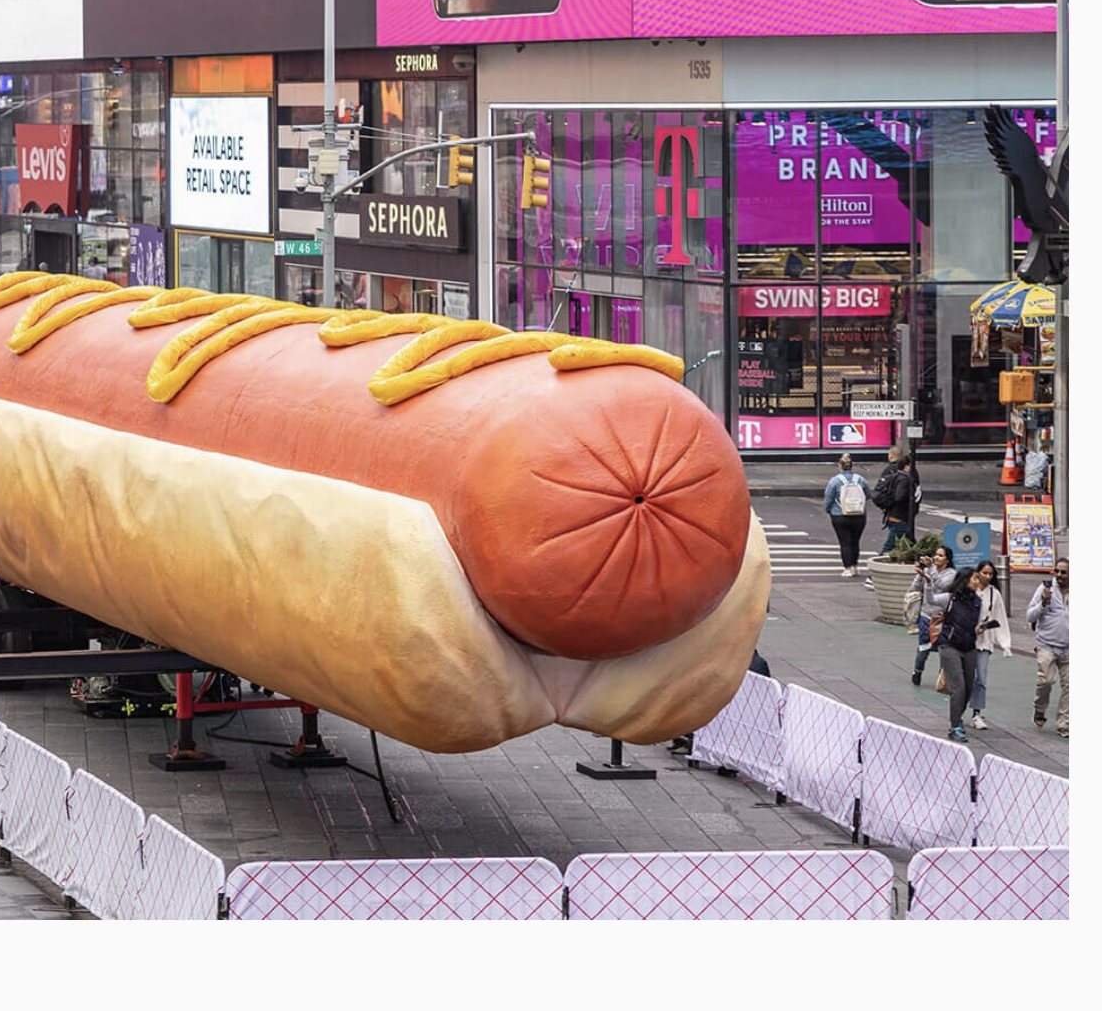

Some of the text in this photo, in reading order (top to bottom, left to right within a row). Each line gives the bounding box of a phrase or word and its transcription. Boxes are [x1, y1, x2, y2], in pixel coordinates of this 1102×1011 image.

[396, 54, 438, 72] SEPHORA
[688, 60, 711, 79] 1535
[193, 136, 244, 160] AVAILABLE
[186, 168, 251, 195] RETAIL SPACE
[821, 198, 867, 212] Hilton
[368, 201, 448, 238] SEPHORA
[286, 244, 295, 253] W
[299, 243, 311, 253] 46
[755, 288, 879, 308] SWING BIG!
[741, 360, 760, 369] PLAY
